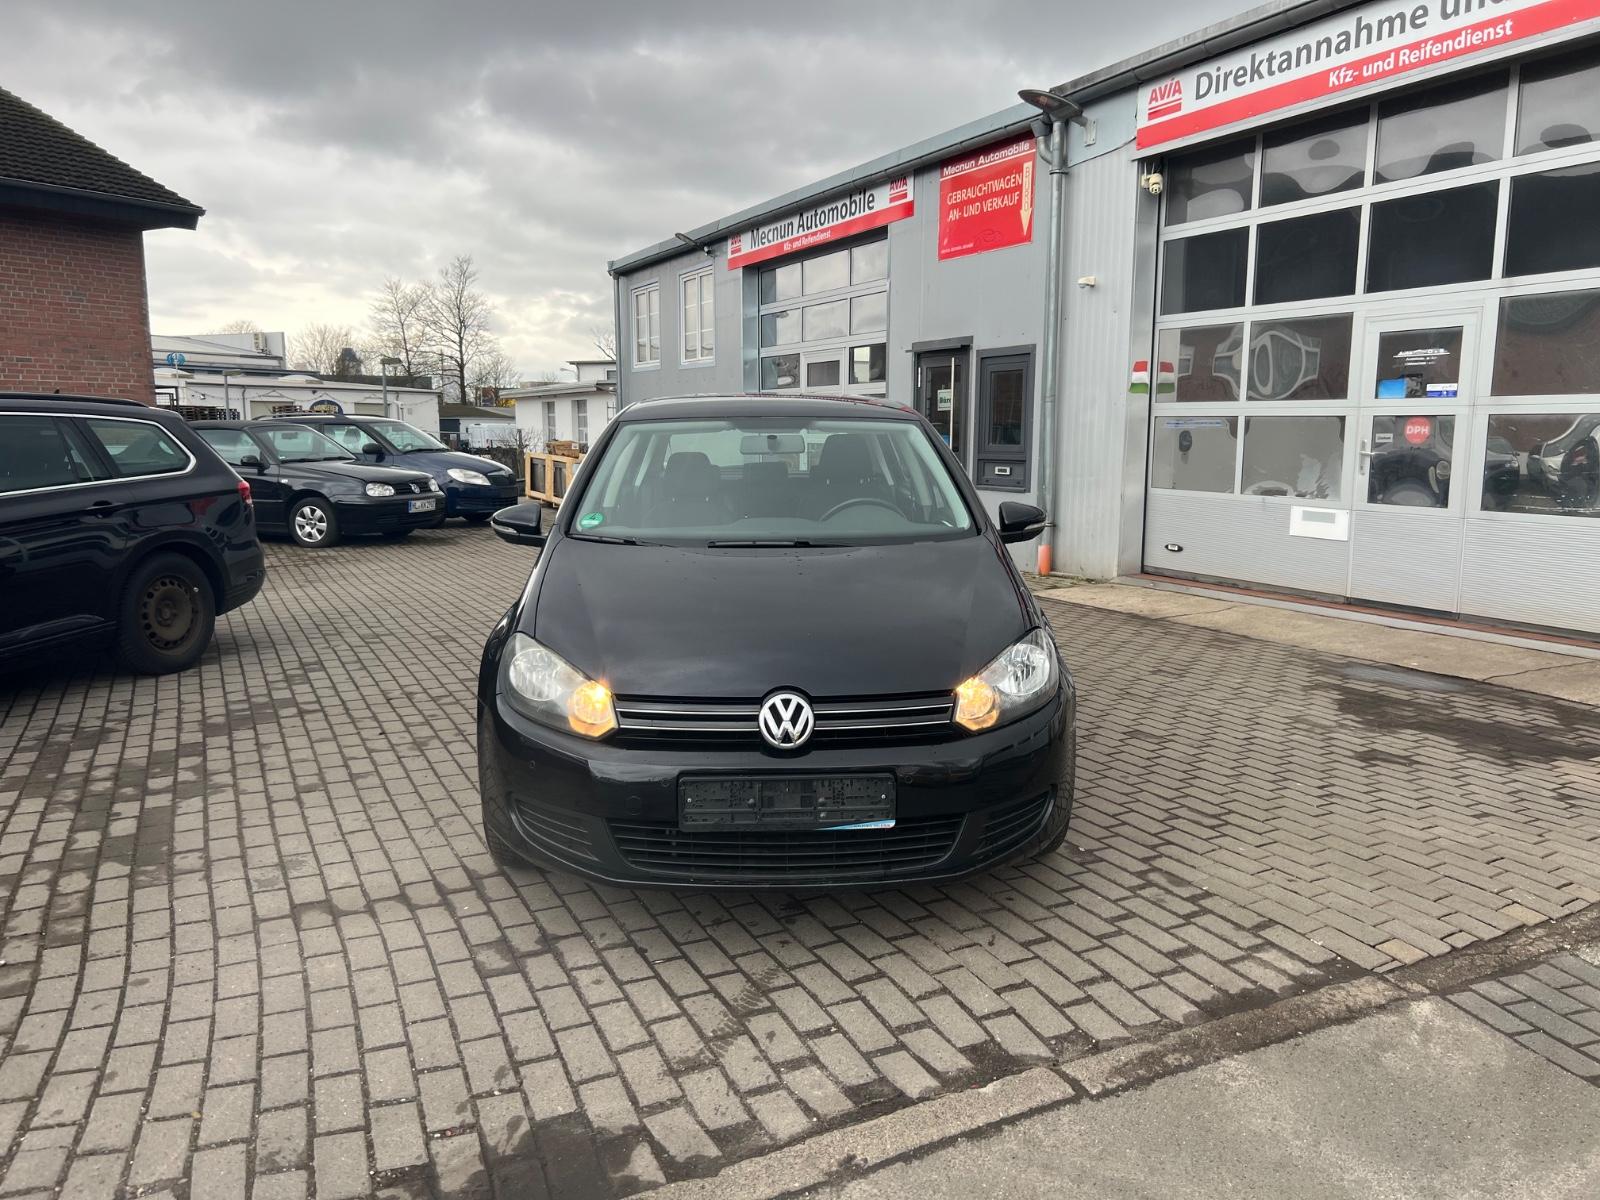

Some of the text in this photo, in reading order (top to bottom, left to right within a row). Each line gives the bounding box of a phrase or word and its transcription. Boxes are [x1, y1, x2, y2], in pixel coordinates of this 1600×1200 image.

[1195, 4, 1428, 101] Direktannahme
[1328, 19, 1513, 88] Kfz- und Reifendienst
[943, 142, 1030, 176] Mecnun Automobile
[947, 173, 1023, 205] GEBRAUCHTWAGEN
[750, 189, 875, 249] Mecnun Automobile
[948, 192, 1020, 222] AN- UND VERKAUF
[793, 239, 802, 249] und
[802, 230, 831, 246] Reifendienst
[1406, 425, 1430, 434] DPH
